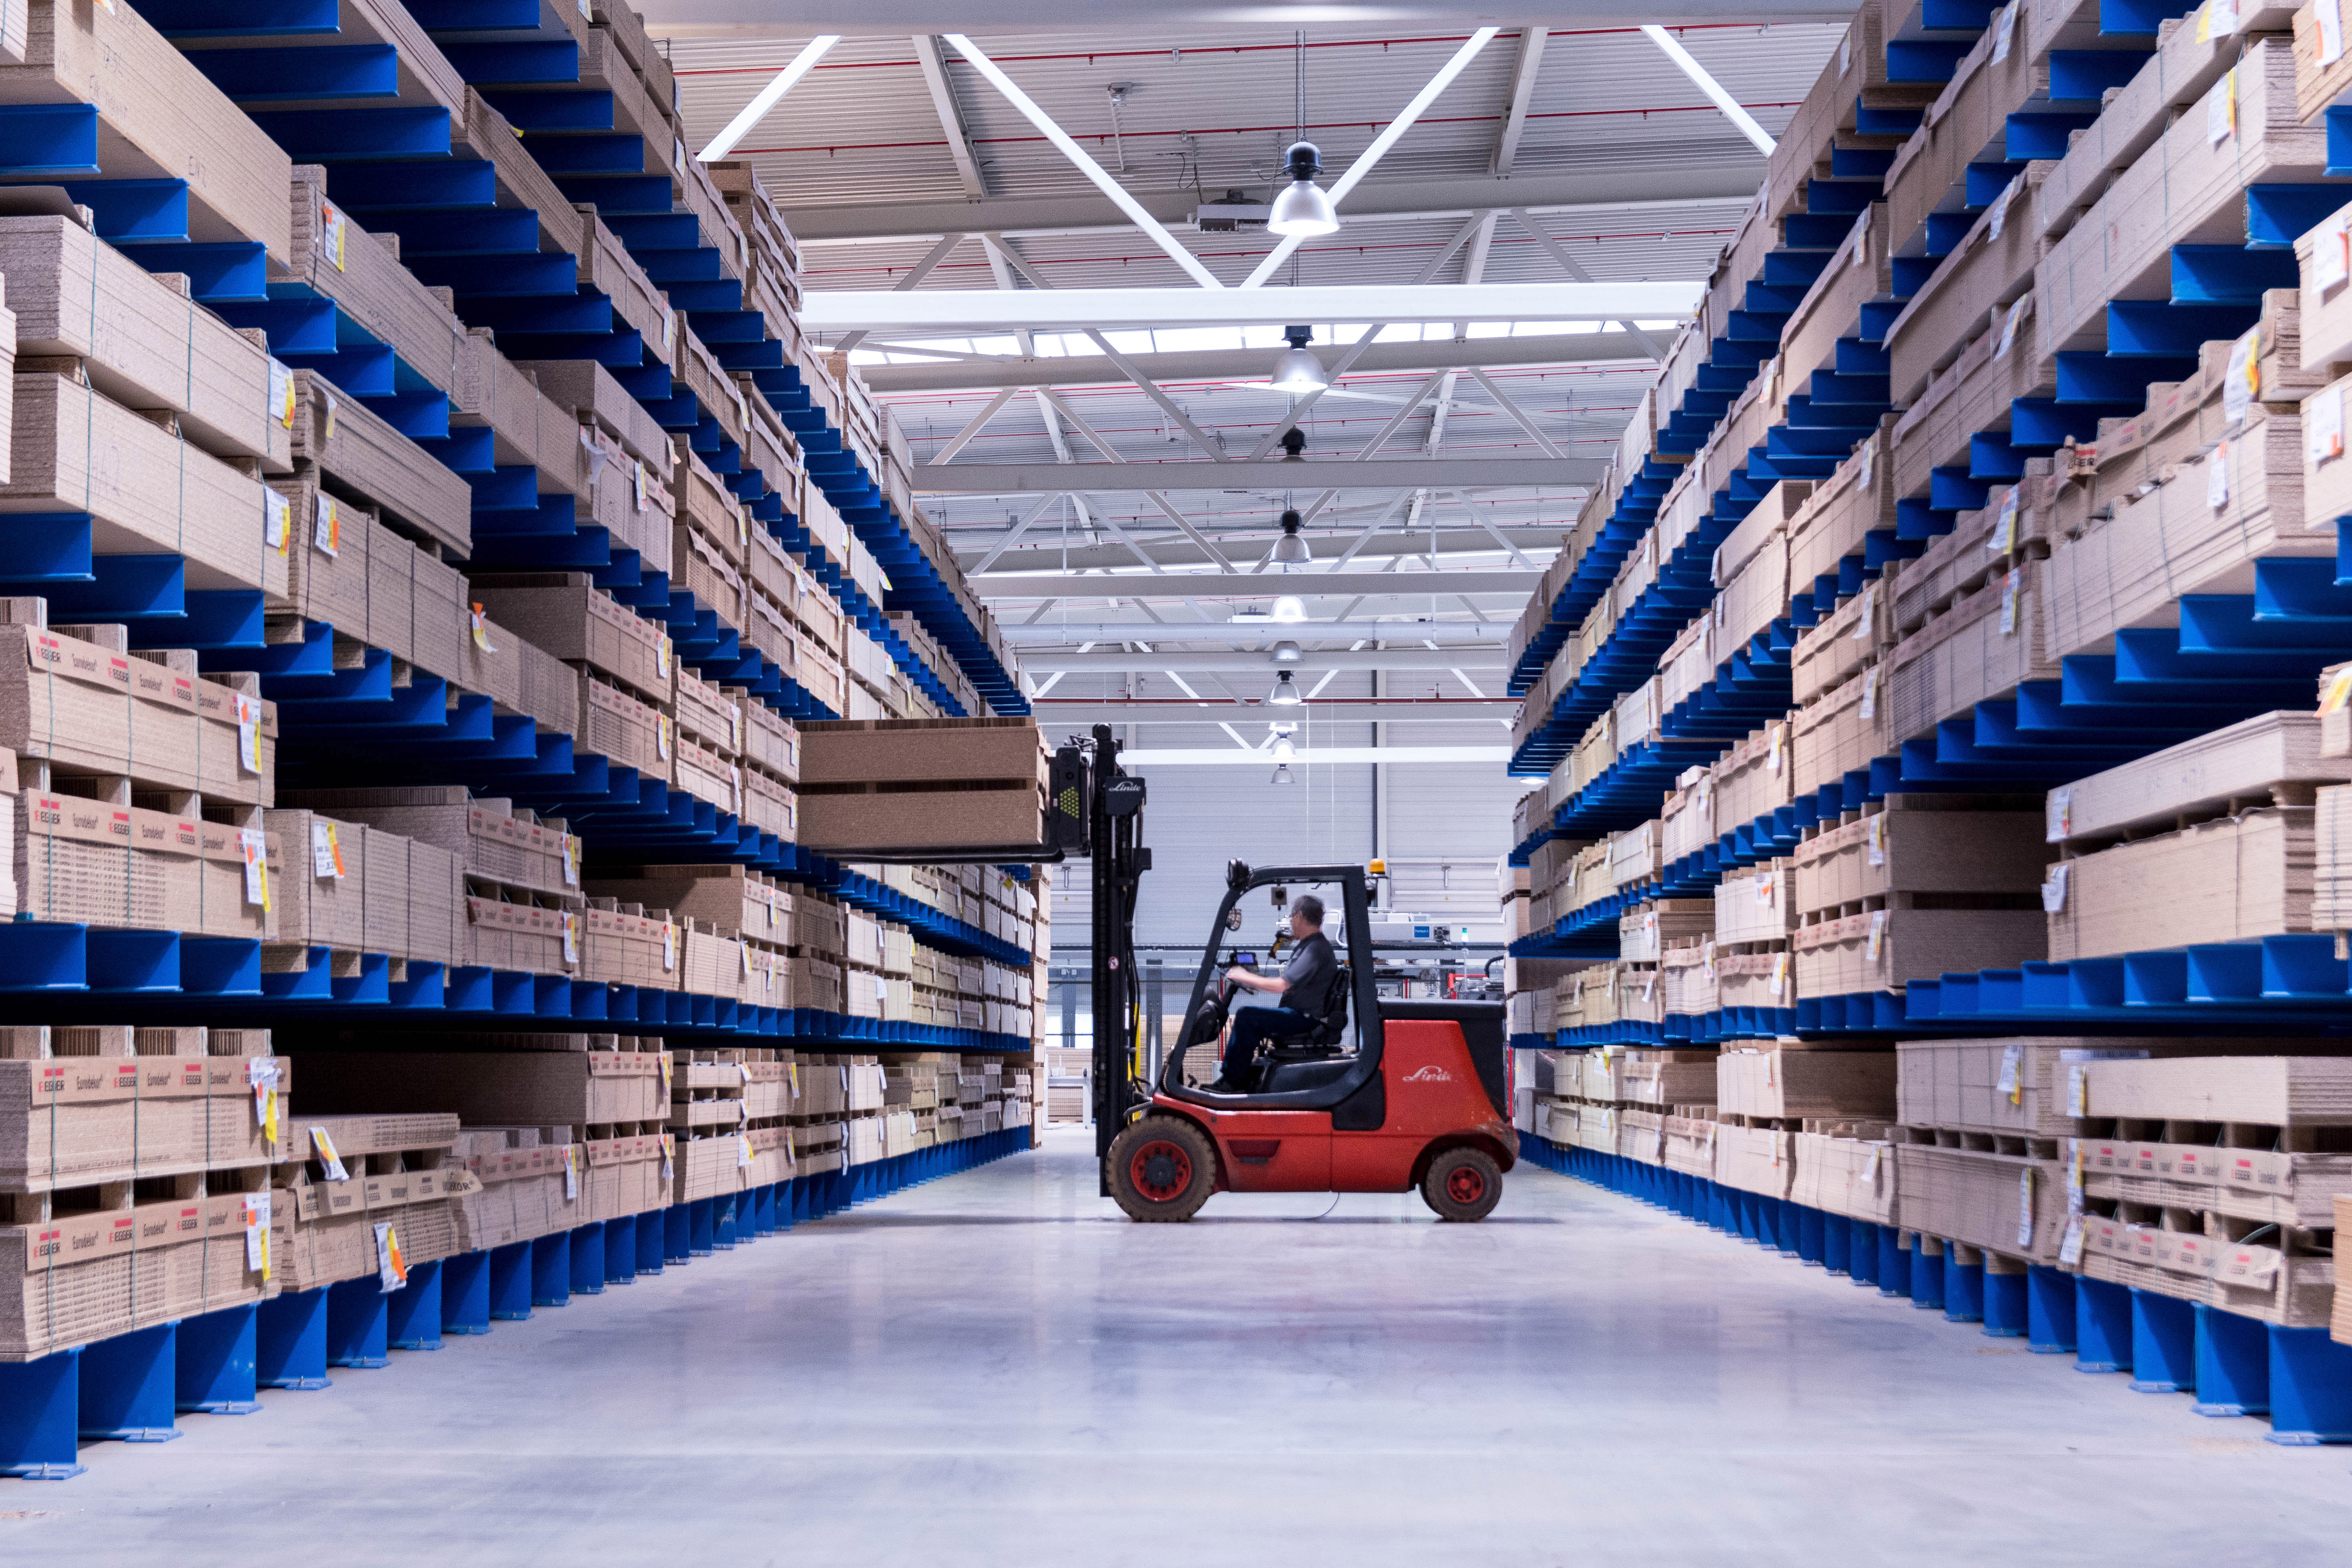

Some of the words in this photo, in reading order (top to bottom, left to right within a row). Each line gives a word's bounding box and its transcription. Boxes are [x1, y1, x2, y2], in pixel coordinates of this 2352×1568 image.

[1108, 781, 1142, 792] Linde
[40, 811, 60, 825] EGER
[44, 1080, 65, 1092] EGER
[40, 1242, 61, 1257] EGER
[114, 1229, 133, 1242] EGGER
